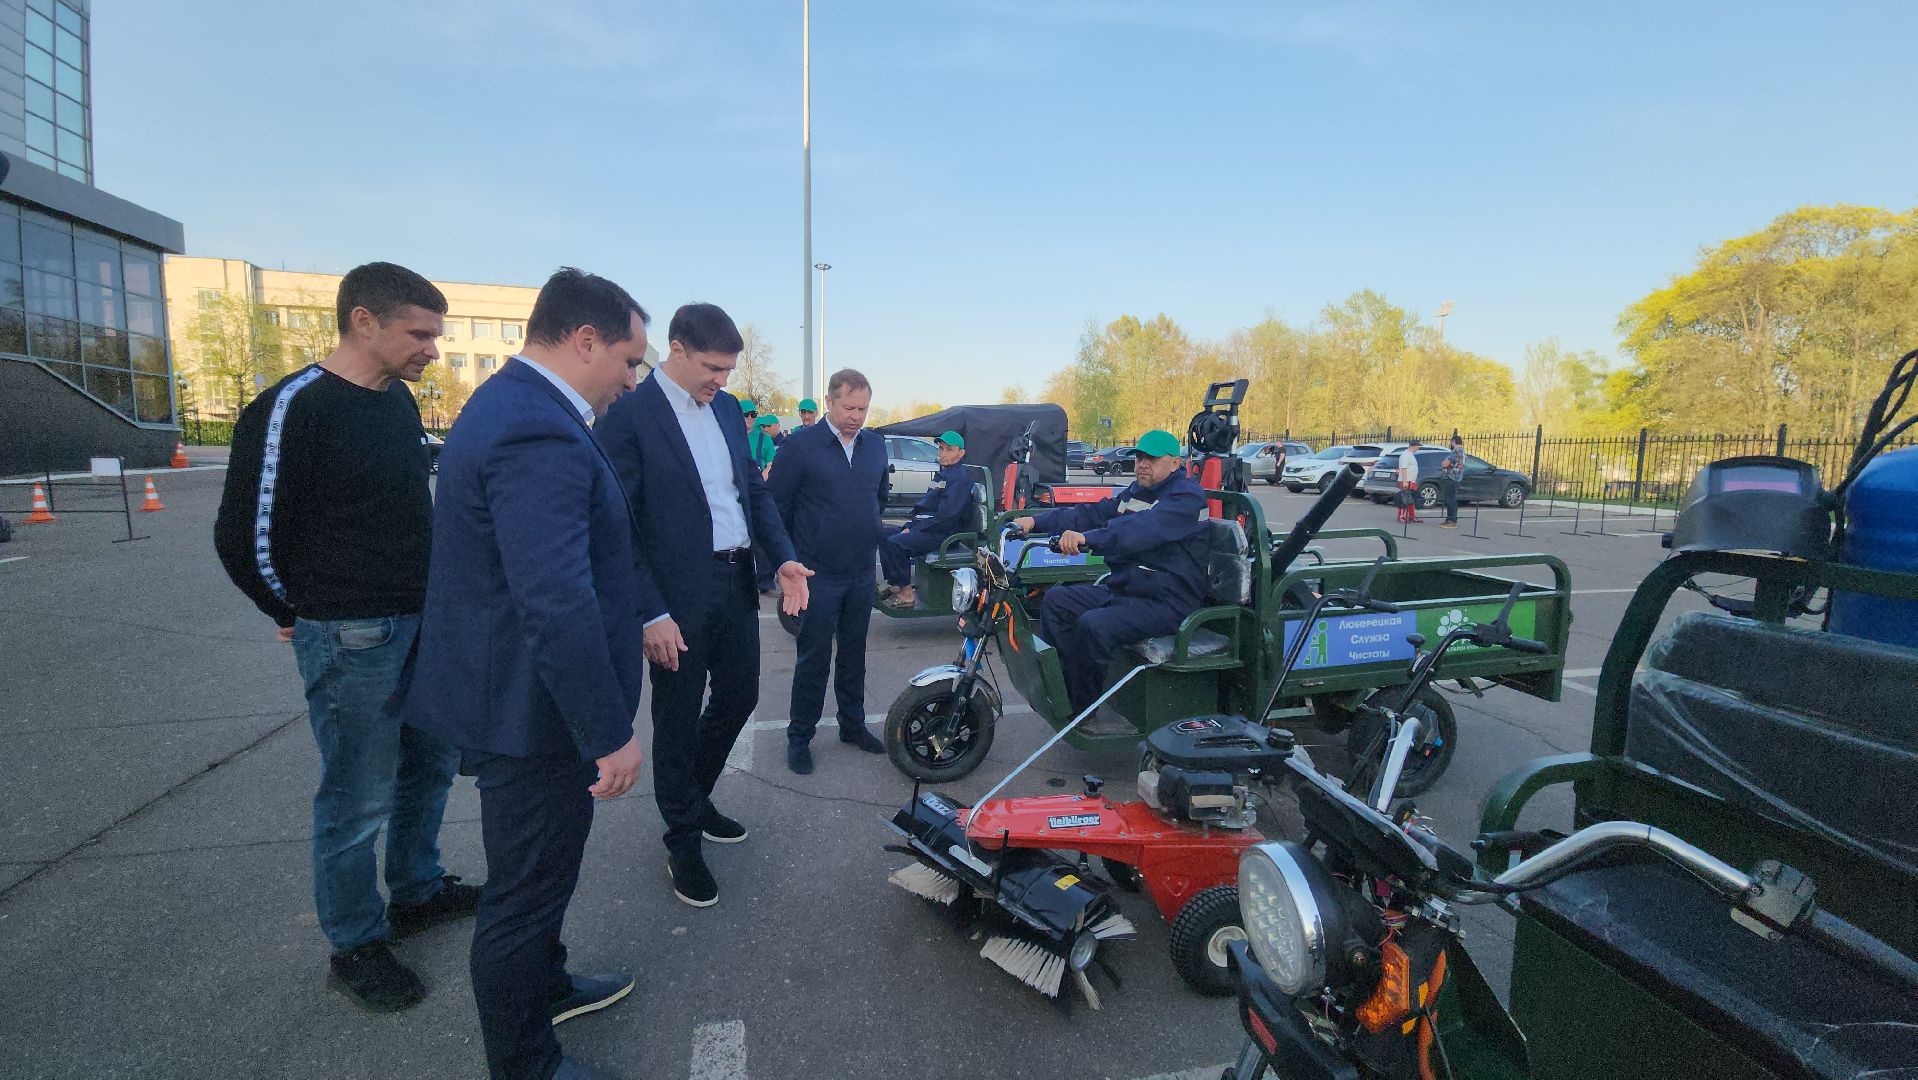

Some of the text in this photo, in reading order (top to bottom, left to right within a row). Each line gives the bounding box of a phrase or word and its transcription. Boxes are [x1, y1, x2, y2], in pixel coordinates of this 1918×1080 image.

[1338, 617, 1402, 630] Люберецкая
[1350, 633, 1390, 645] Служба
[1348, 650, 1390, 660] Чистоты
